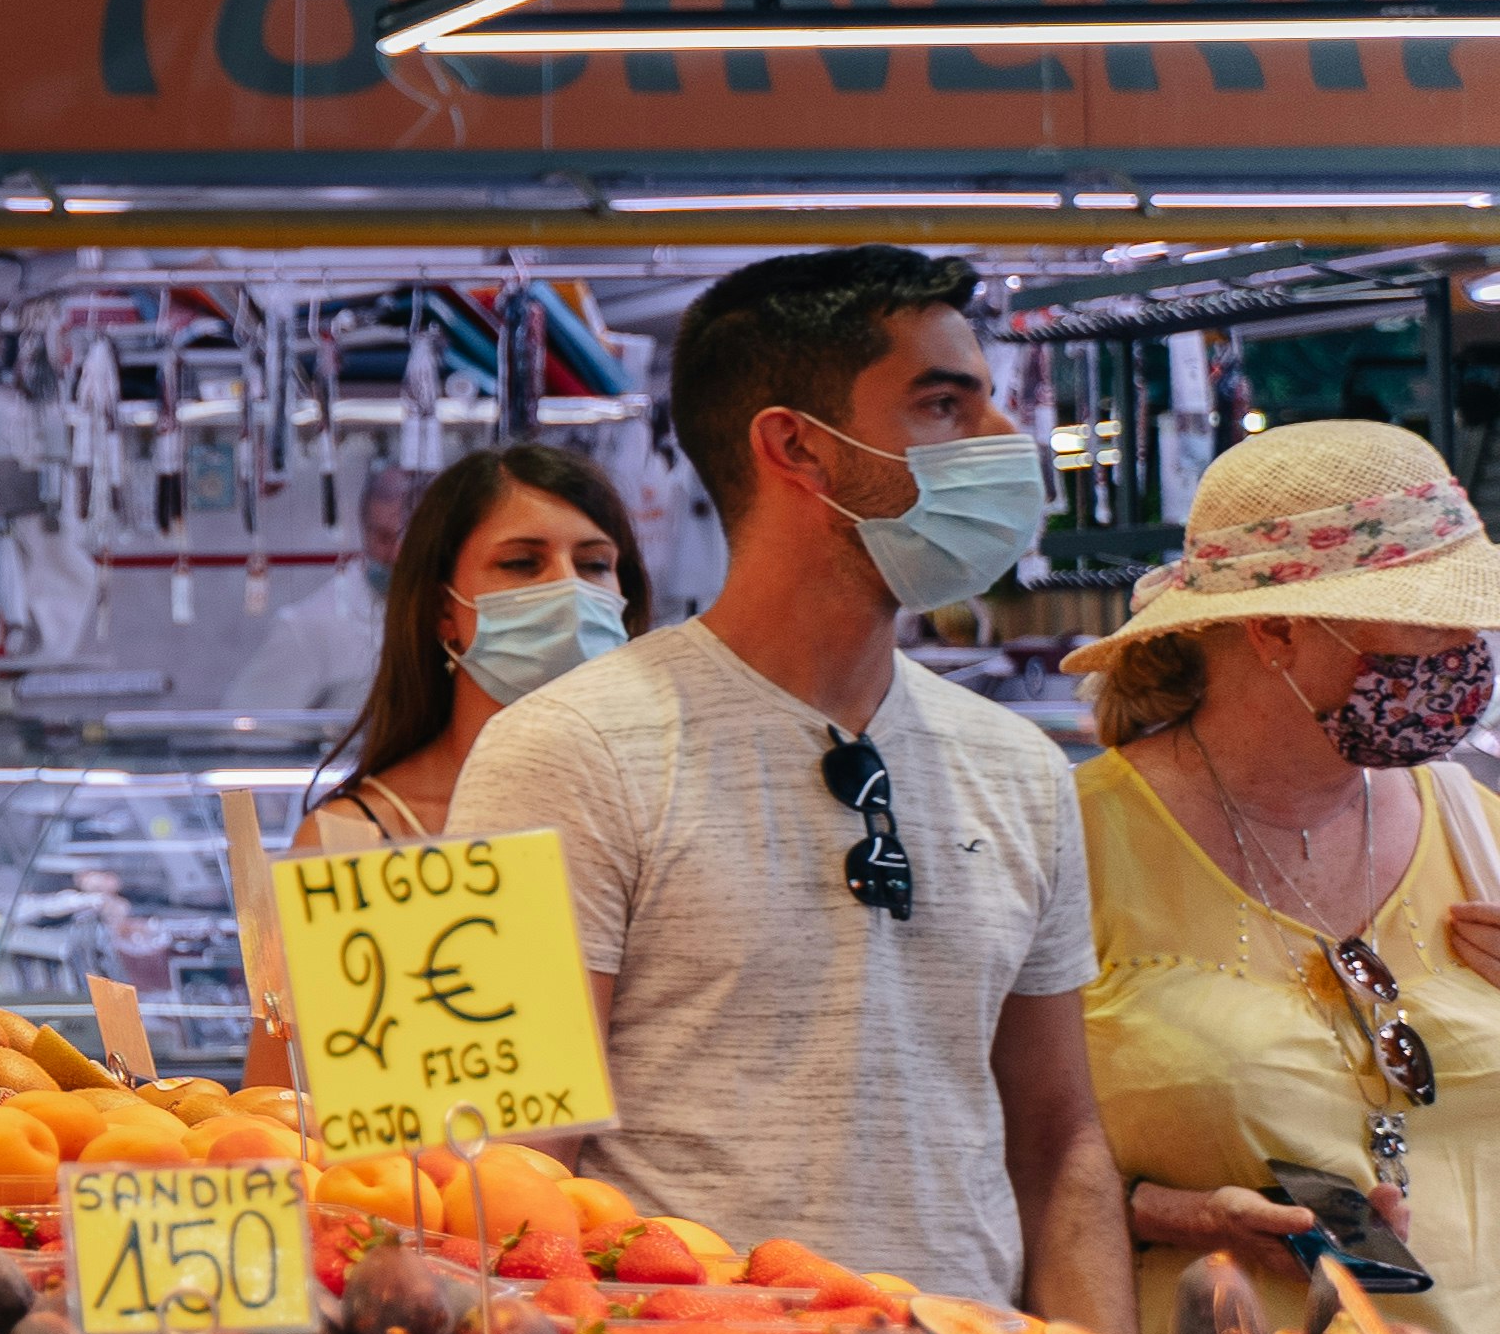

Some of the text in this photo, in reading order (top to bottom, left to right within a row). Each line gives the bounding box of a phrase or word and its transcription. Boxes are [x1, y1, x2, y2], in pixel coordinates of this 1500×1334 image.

[295, 839, 501, 924] HIGOS
[421, 1038, 520, 1089] FIGS
[496, 1089, 574, 1130] BOX
[75, 1167, 304, 1212] SANDIAS
